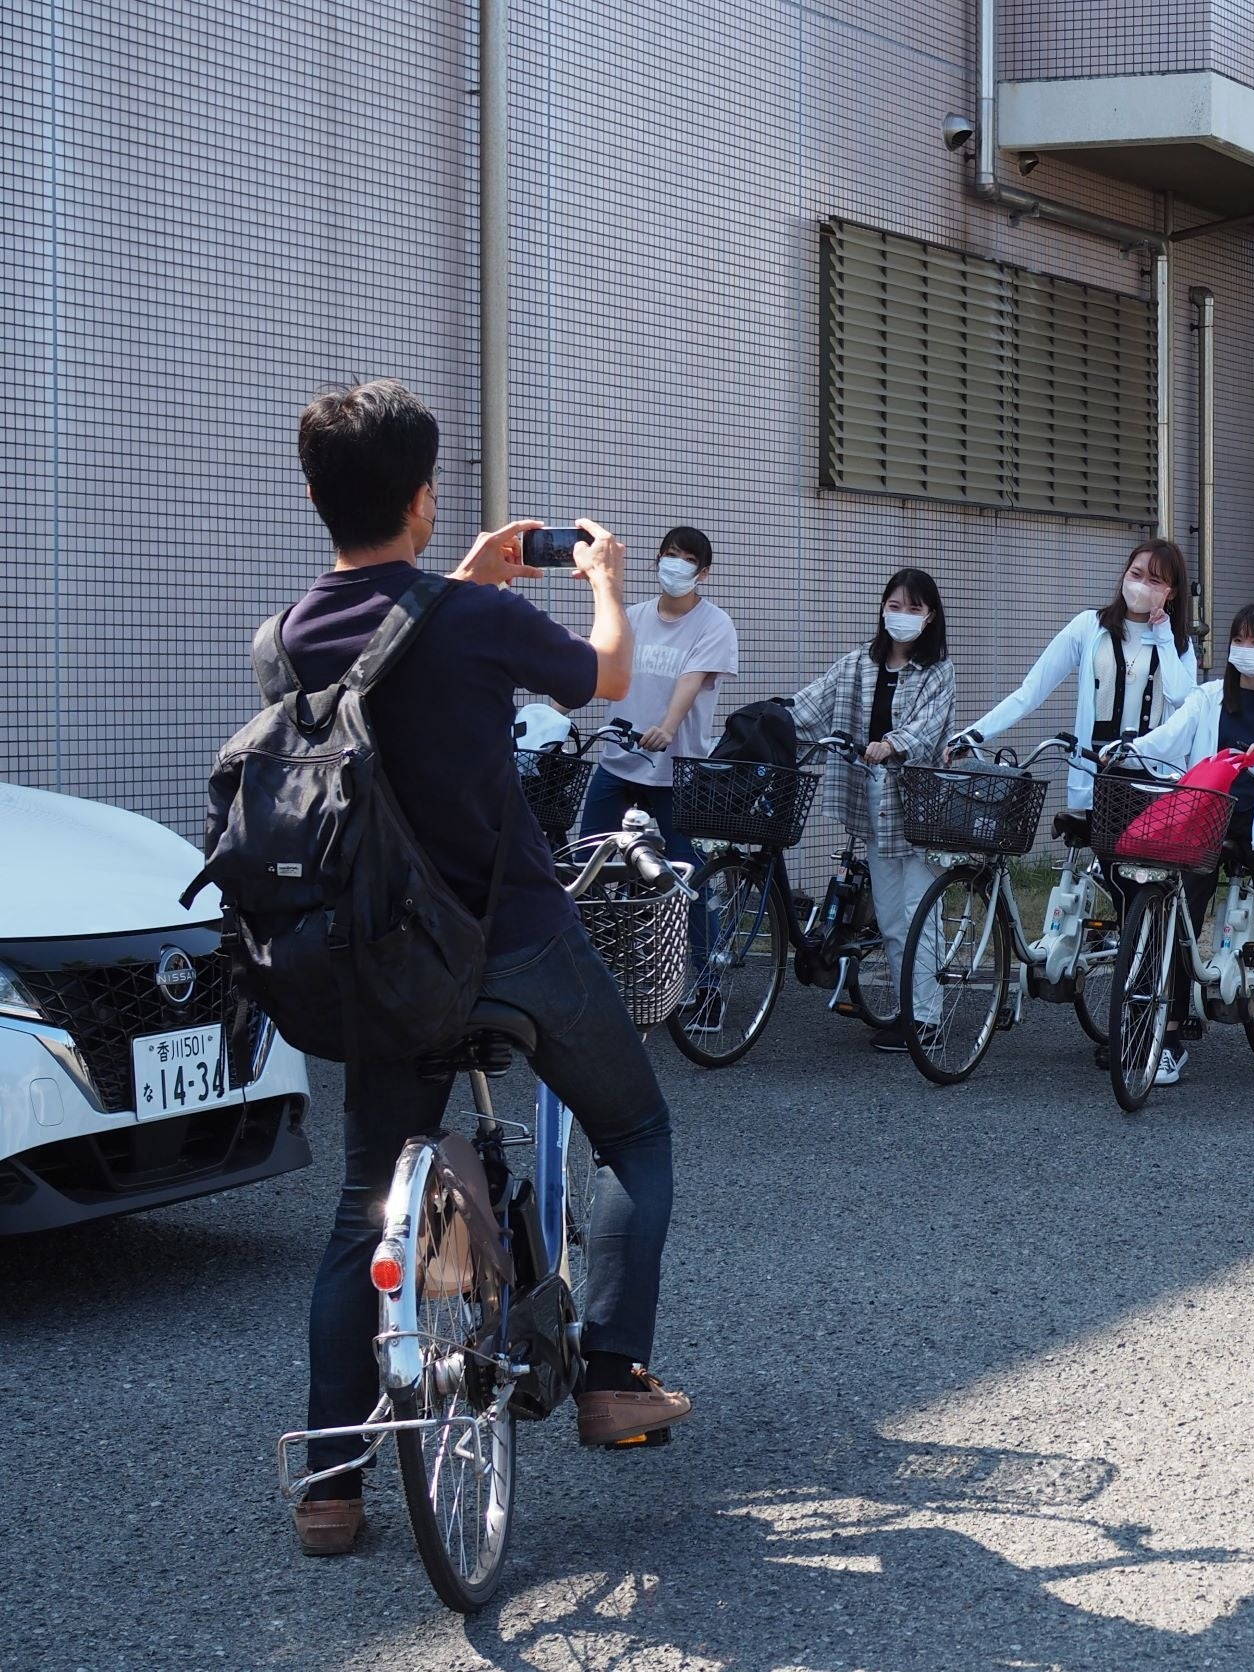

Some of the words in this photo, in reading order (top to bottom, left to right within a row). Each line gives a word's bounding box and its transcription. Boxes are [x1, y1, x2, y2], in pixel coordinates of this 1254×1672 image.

[157, 972, 196, 984] NISSAN
[143, 1082, 154, 1103] な
[161, 1057, 225, 1110] 14-34
